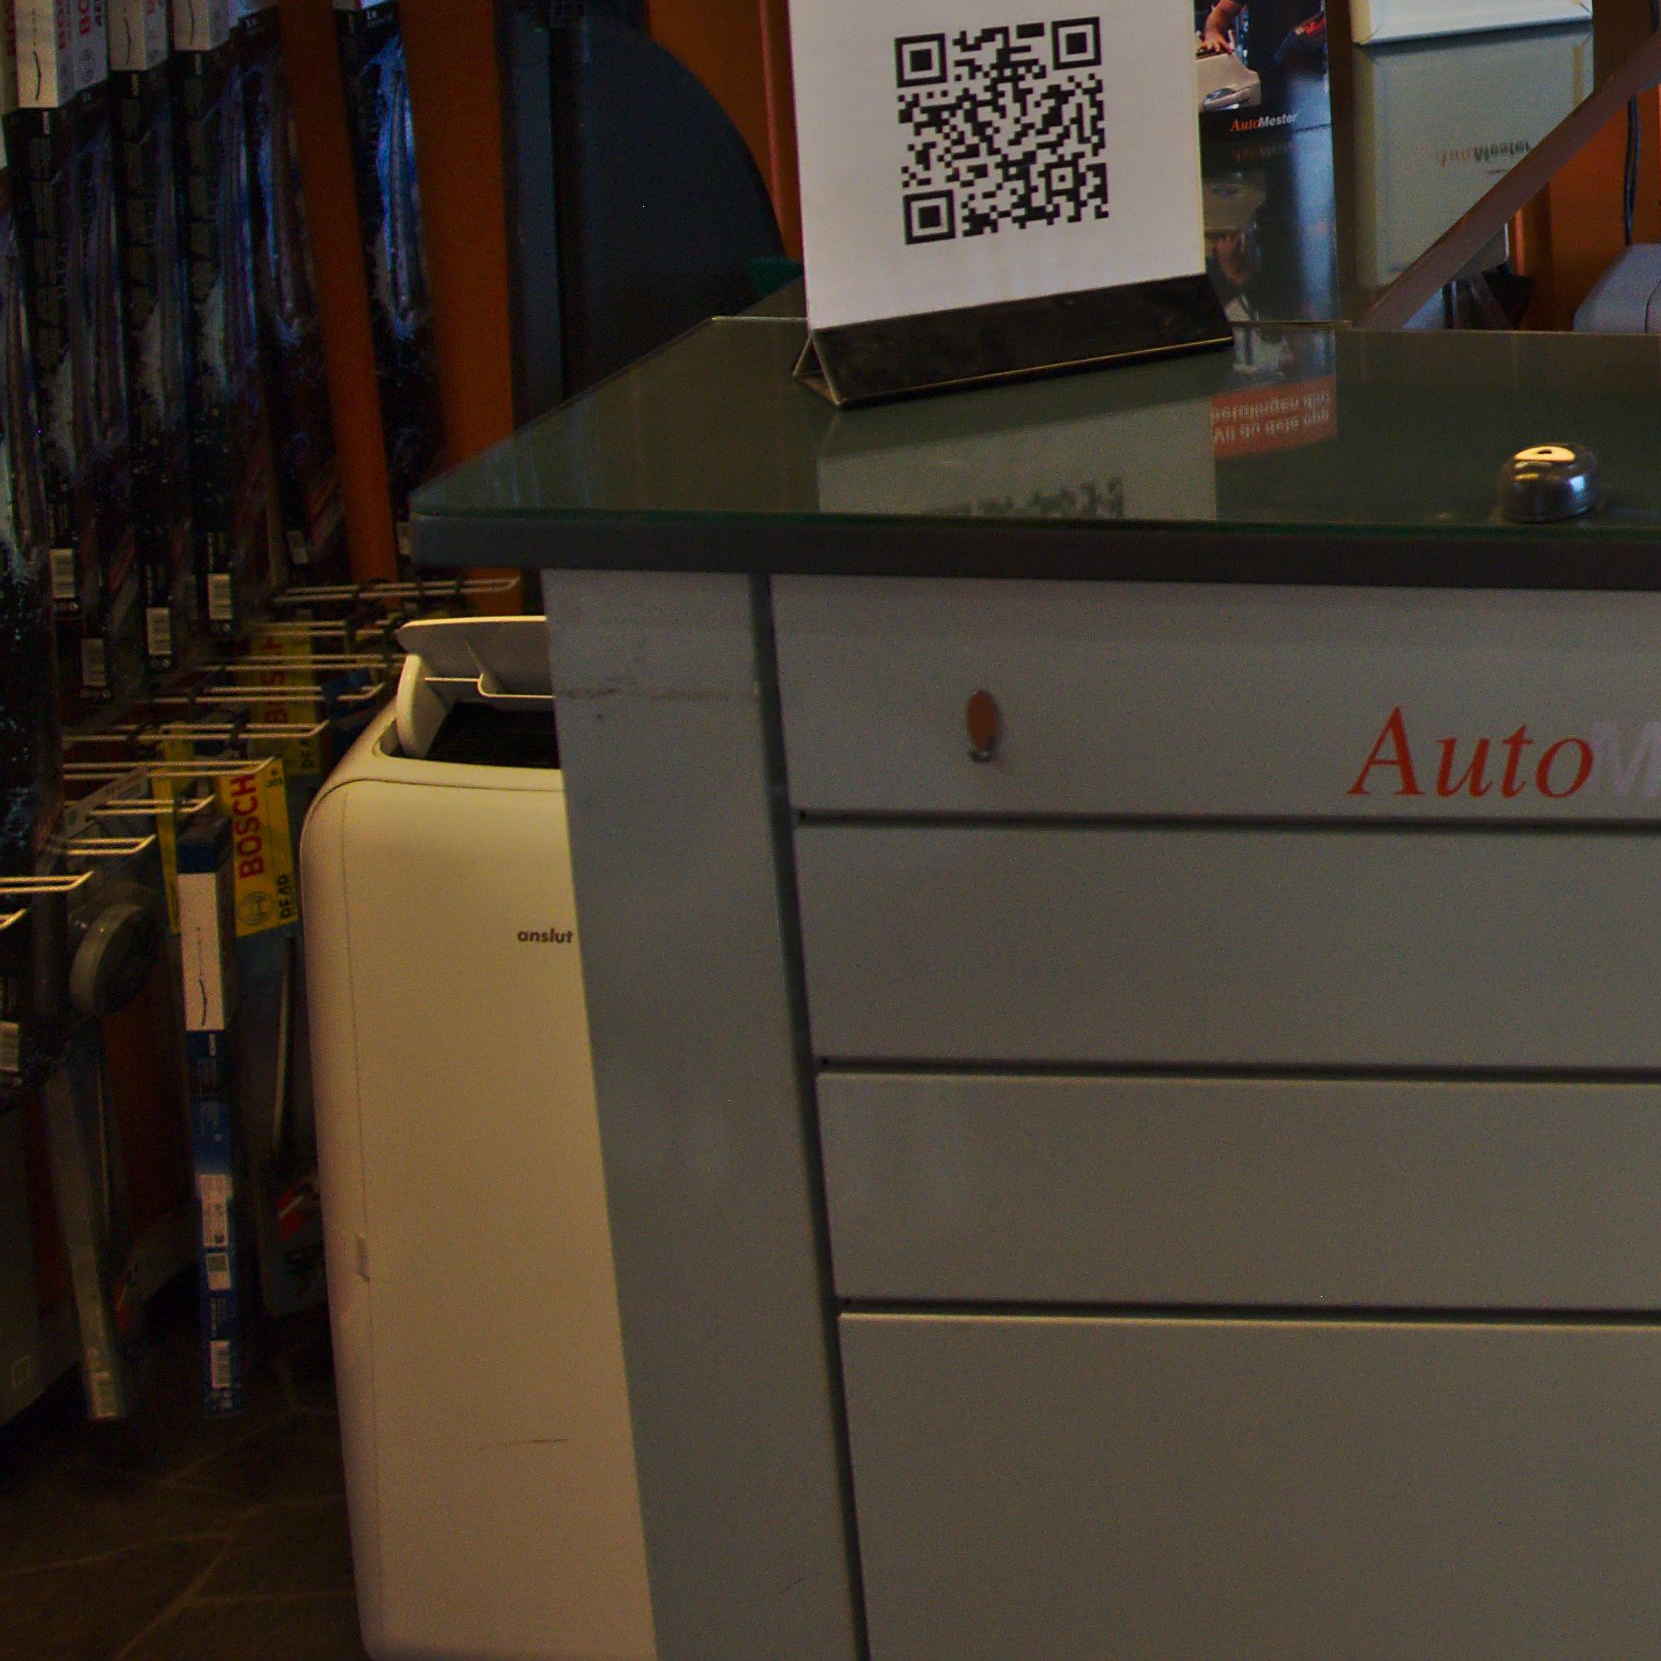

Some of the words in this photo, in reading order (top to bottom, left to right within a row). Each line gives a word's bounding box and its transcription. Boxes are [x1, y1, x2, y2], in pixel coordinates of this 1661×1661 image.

[1229, 111, 1299, 134] AutoMester
[231, 774, 265, 879] BOSCH
[516, 927, 573, 946] anslut
